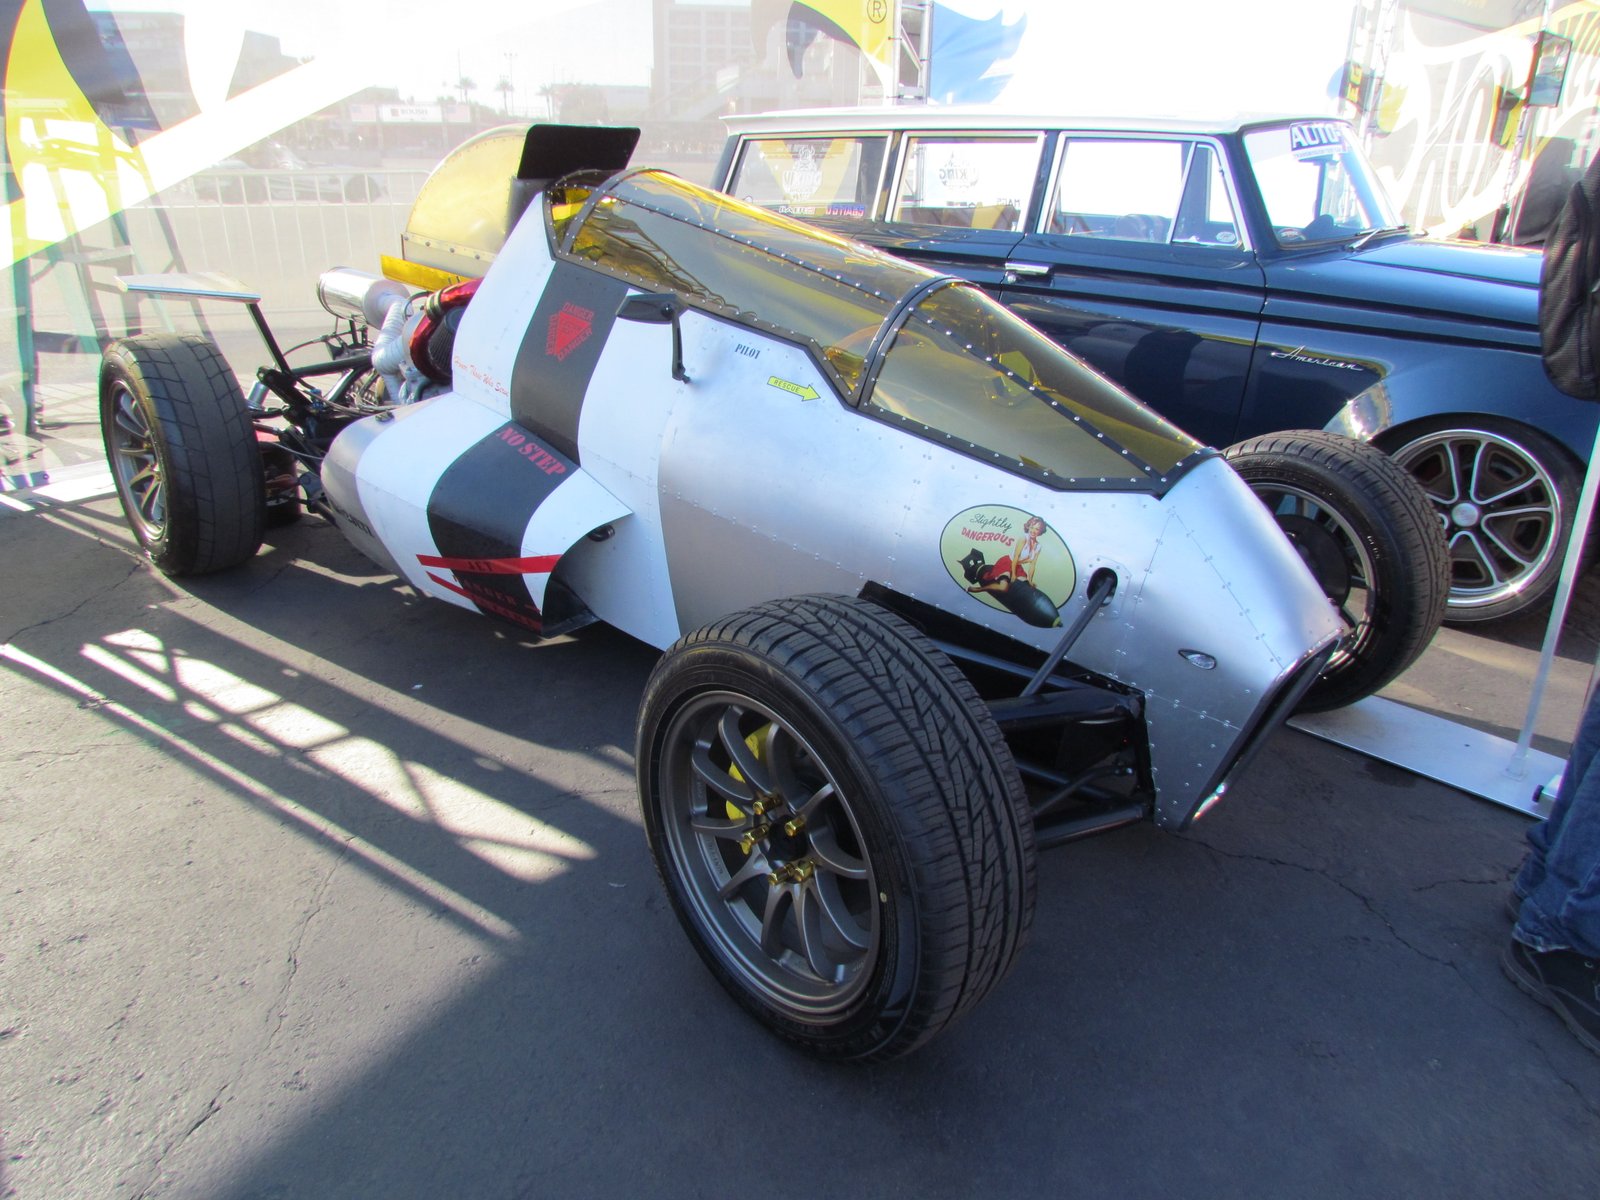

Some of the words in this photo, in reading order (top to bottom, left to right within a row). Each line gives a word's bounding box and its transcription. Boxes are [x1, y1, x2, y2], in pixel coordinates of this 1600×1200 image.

[563, 302, 594, 320] DANGER
[735, 343, 761, 360] PILOT
[1271, 345, 1364, 372] American
[774, 379, 800, 393] RESCUE
[497, 427, 526, 447] NO
[518, 442, 567, 475] STEP
[970, 513, 1012, 534] Slightly
[961, 527, 1015, 547] DANGEROUS
